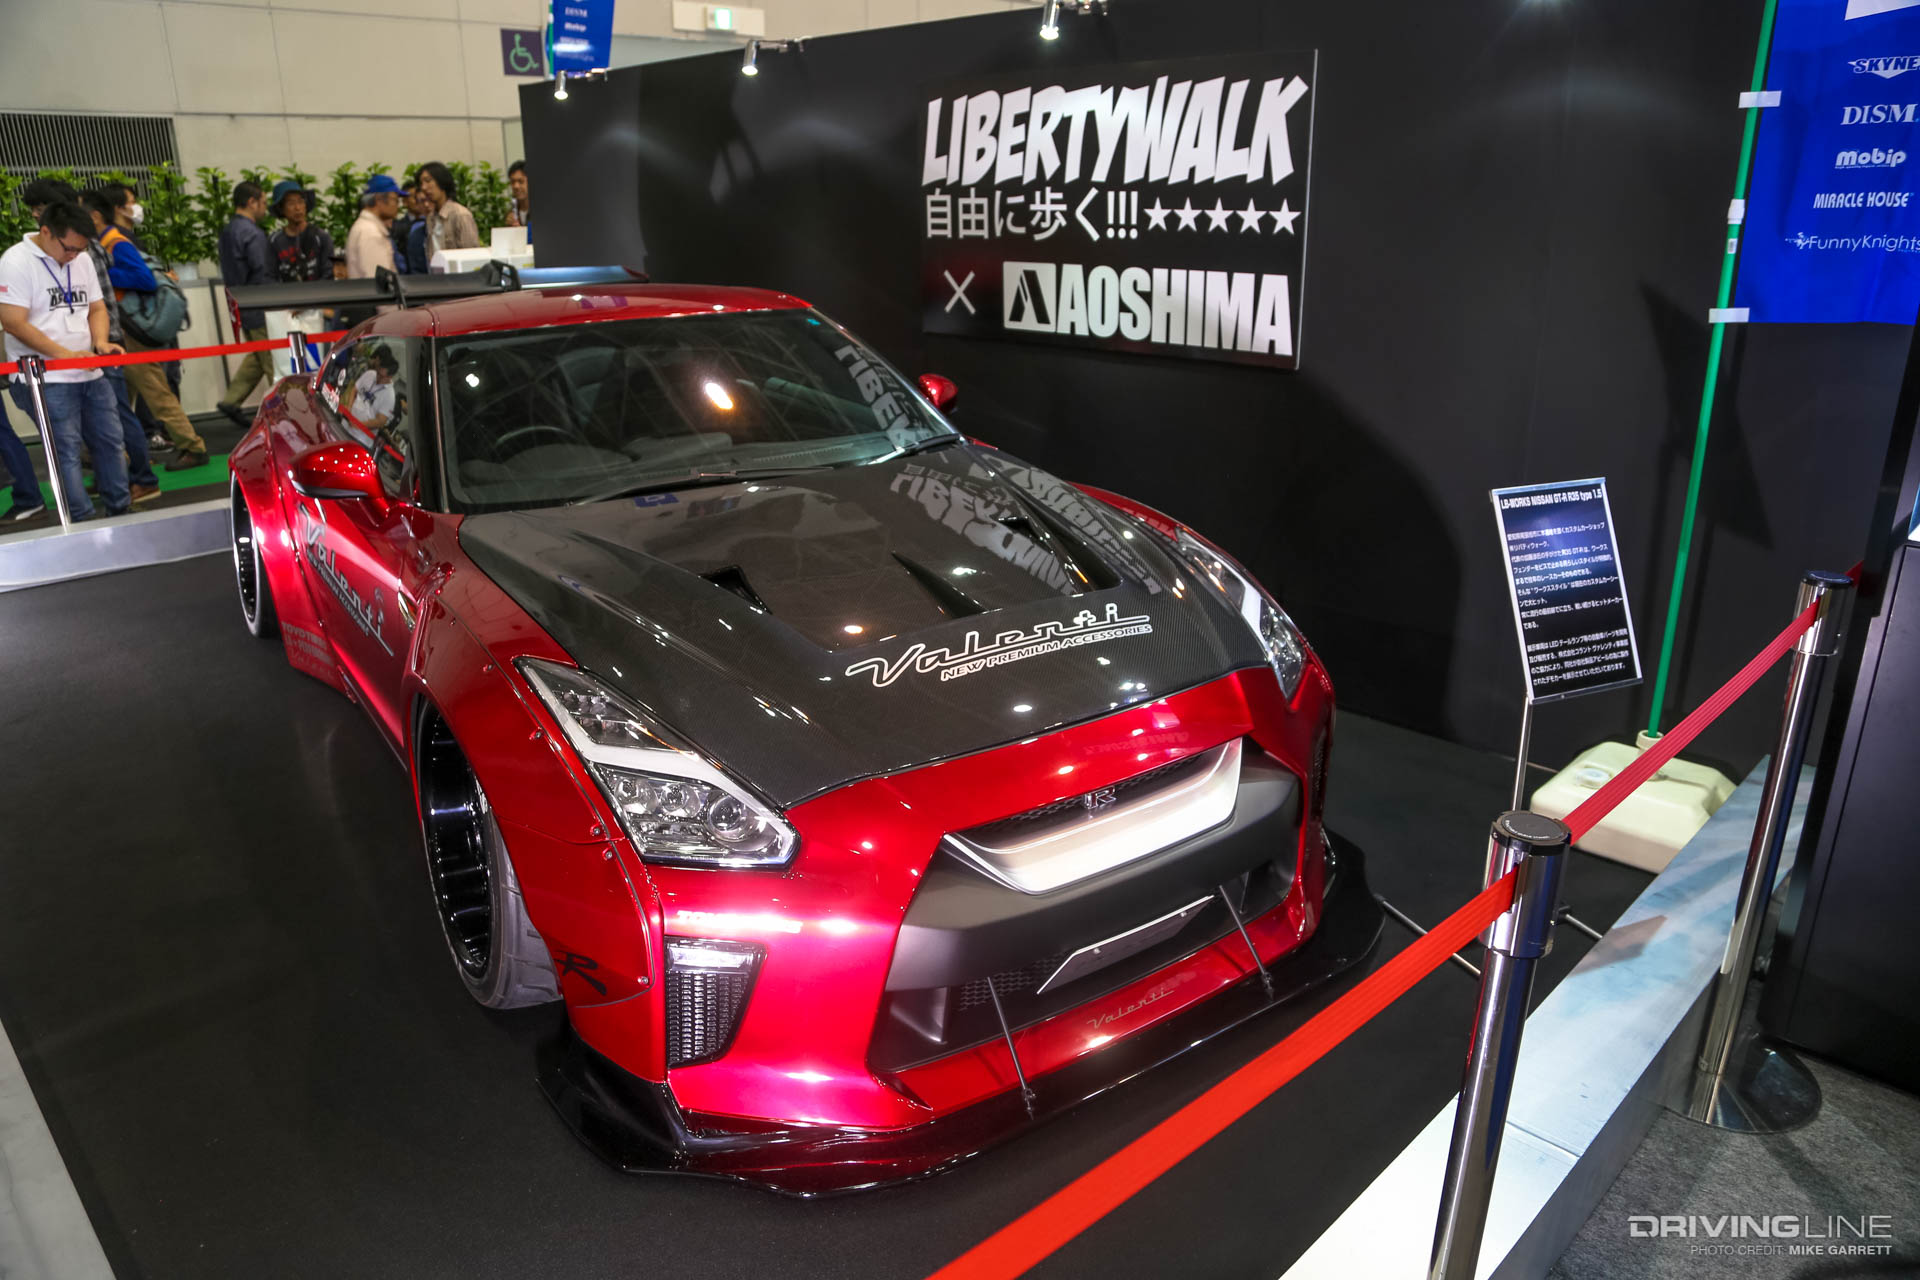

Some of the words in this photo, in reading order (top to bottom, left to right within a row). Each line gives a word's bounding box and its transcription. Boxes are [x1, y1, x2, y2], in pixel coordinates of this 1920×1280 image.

[1813, 192, 1865, 209] MIRACLE
[1866, 191, 1910, 208] HOUSE
[1056, 263, 1293, 356] AOSHIMA
[1531, 493, 1554, 506] NISSAN
[1553, 492, 1568, 503] GT-R
[845, 602, 1150, 687] Valenti
[940, 660, 984, 681] NEW
[986, 642, 1061, 668] PREMIUM
[1060, 622, 1153, 650] ACCESSORIES
[1086, 987, 1174, 1030] Valenti
